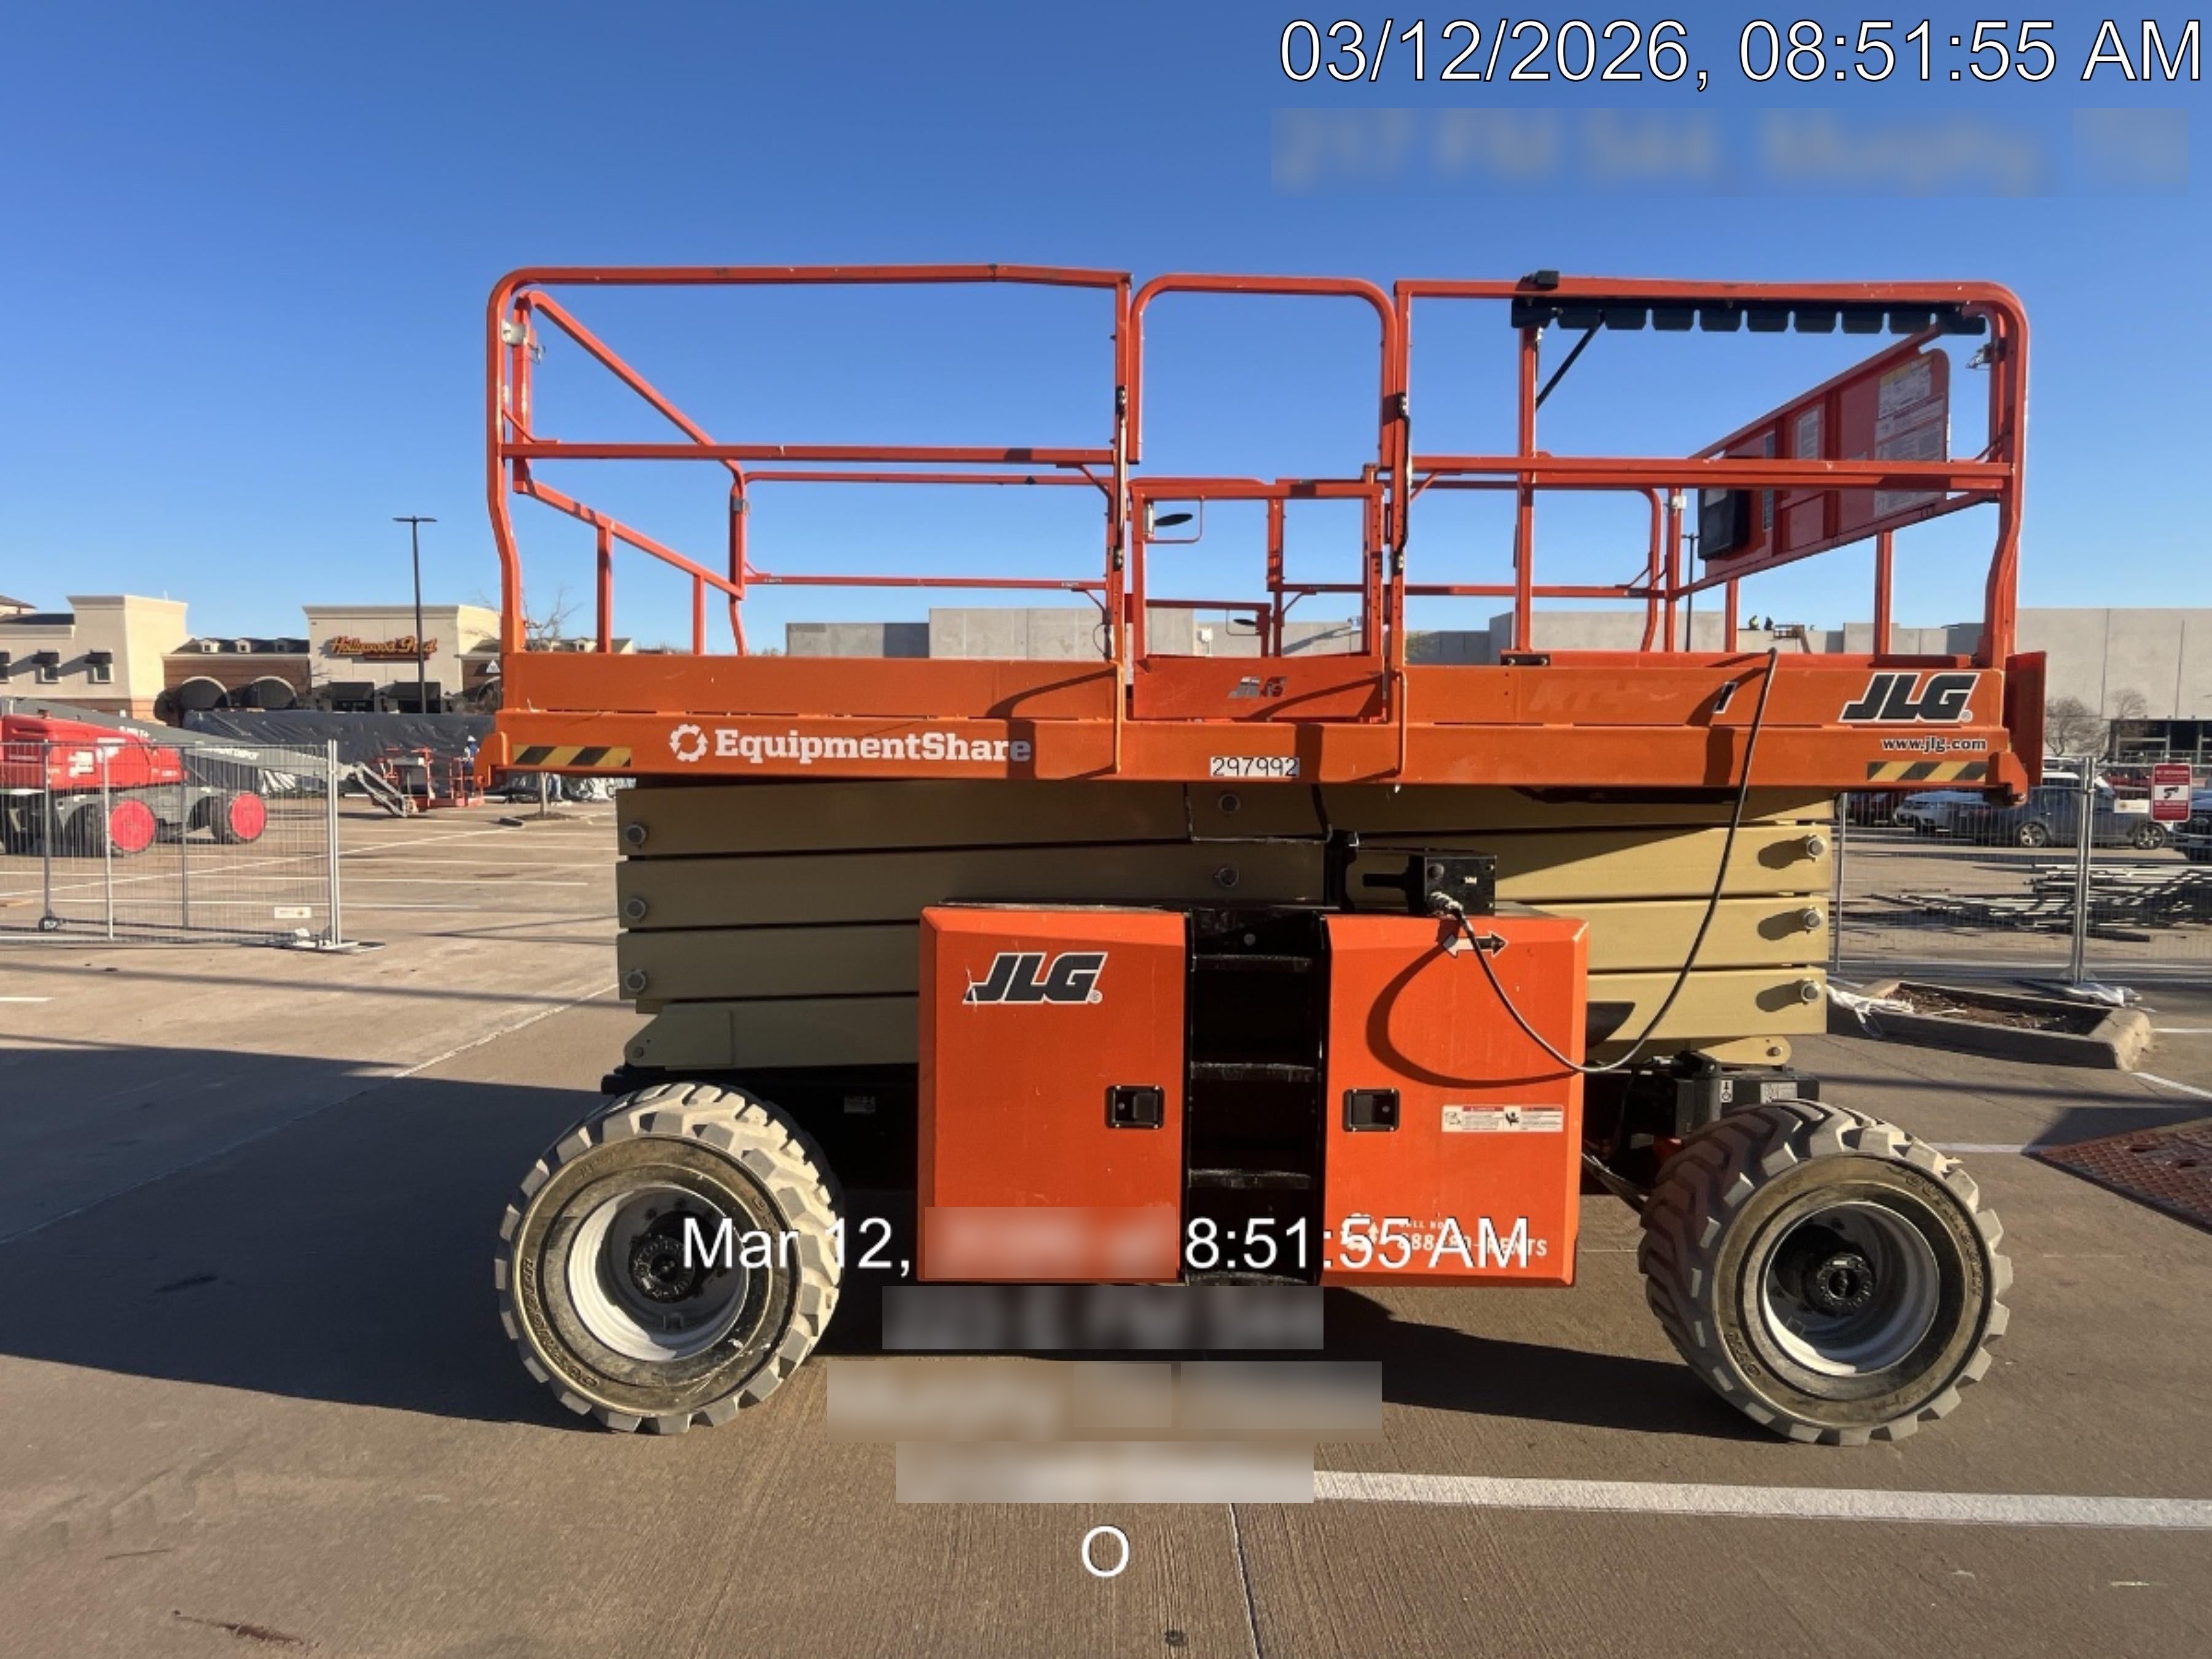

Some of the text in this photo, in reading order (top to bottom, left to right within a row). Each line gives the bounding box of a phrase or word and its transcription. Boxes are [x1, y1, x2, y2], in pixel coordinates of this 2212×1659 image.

[1838, 672, 1980, 723] JLG
[714, 729, 1032, 764] EquipmentShare
[1881, 736, 1987, 753] www.jlg.com
[1212, 757, 1298, 777] 297992
[962, 951, 1108, 1005] JLG
